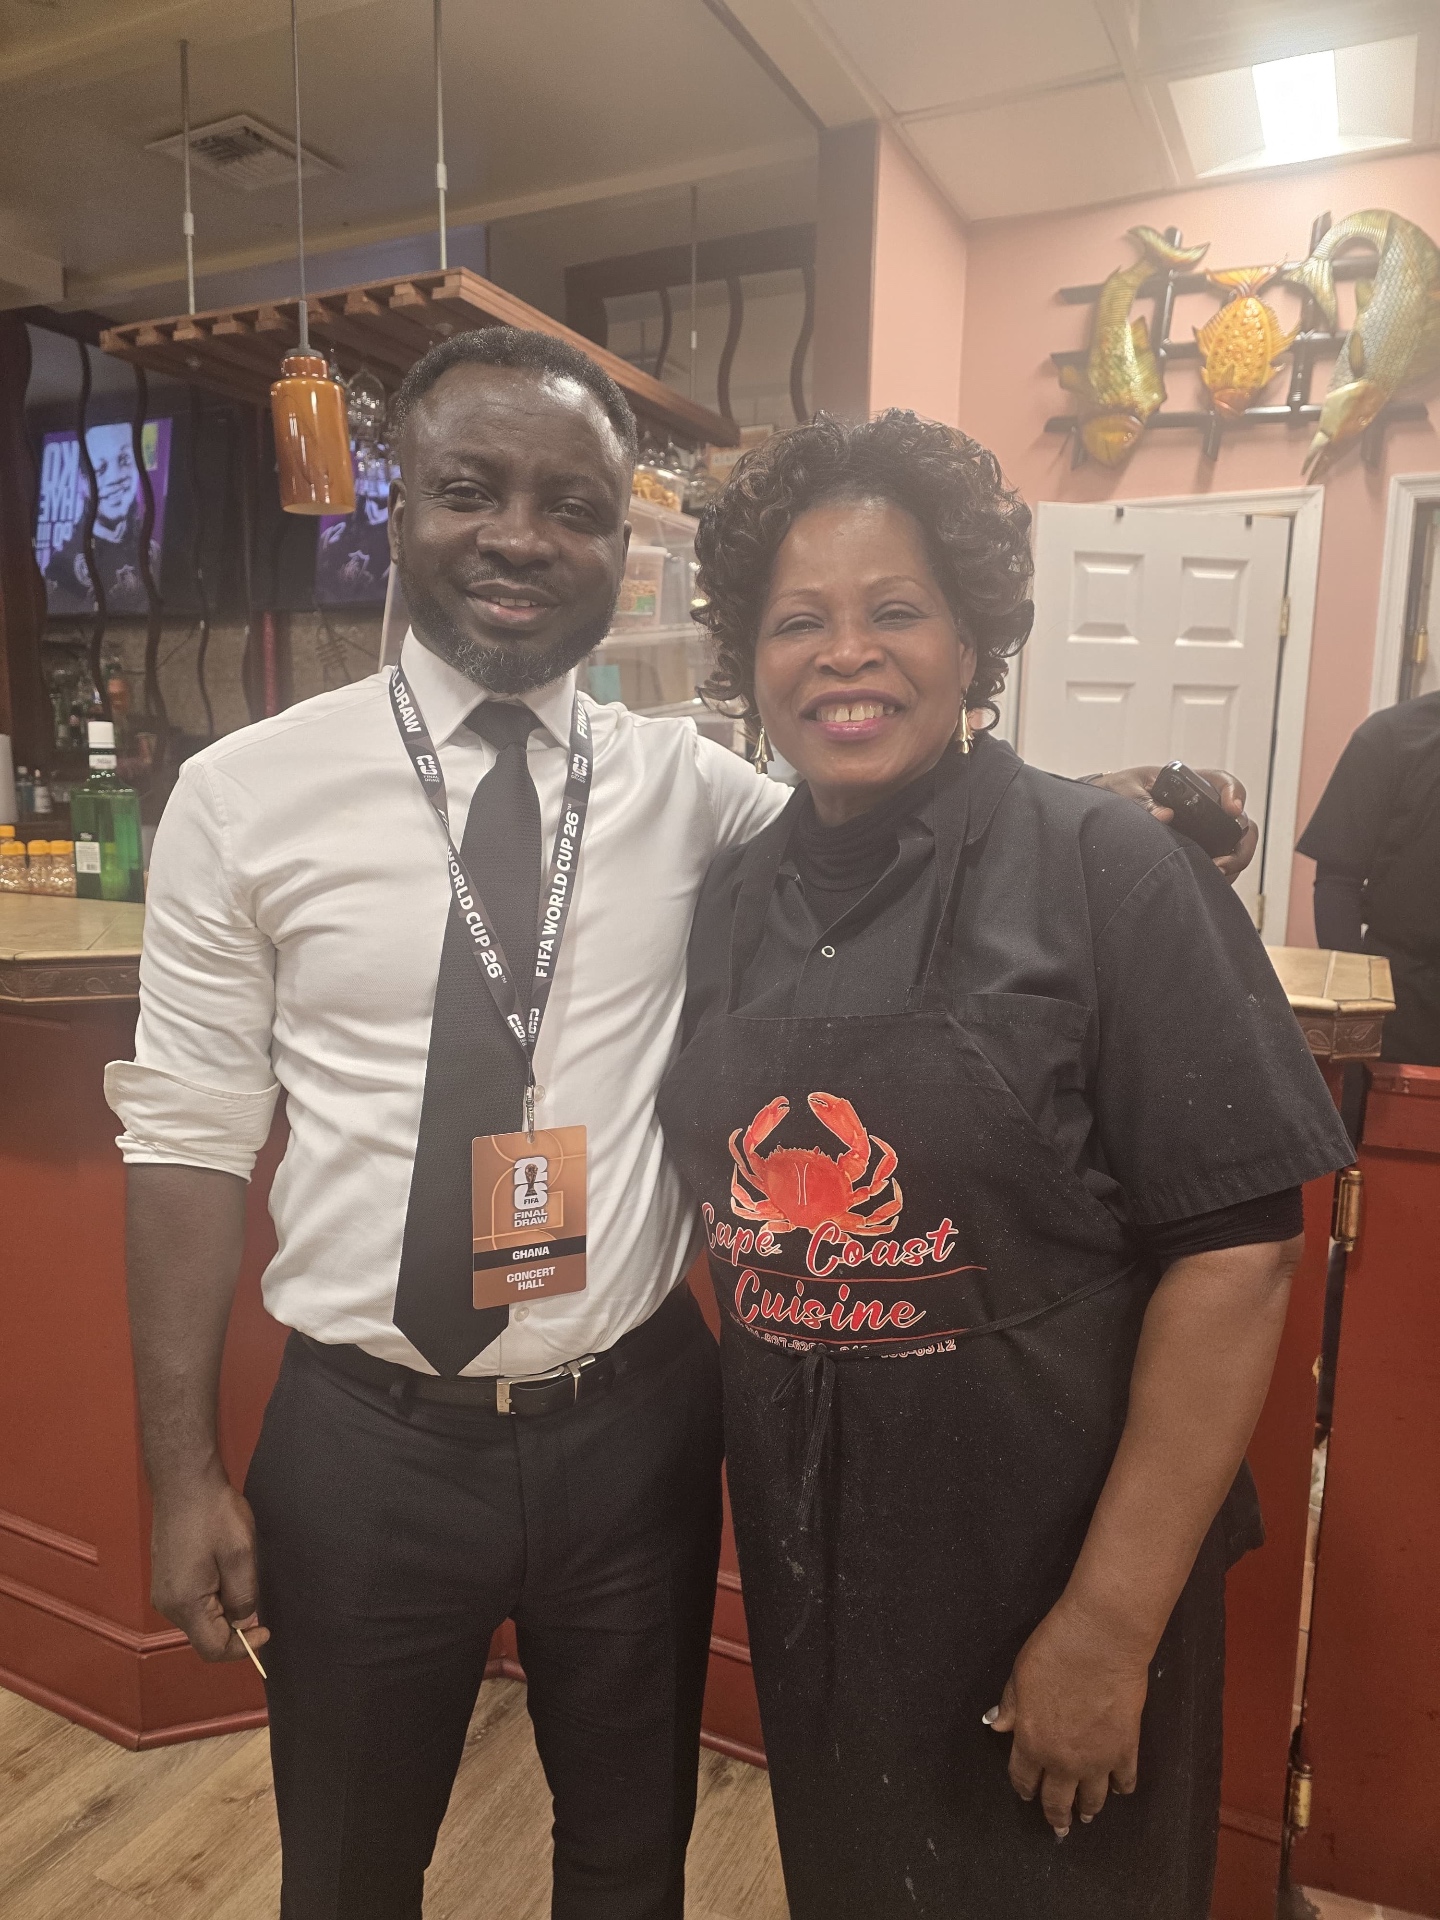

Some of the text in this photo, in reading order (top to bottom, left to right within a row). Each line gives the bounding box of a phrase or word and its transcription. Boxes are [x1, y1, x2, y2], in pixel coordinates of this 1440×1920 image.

[394, 682, 421, 733] DRAW
[556, 838, 574, 872] CUP
[542, 873, 568, 935] WORLD
[465, 911, 491, 948] CUP
[535, 939, 555, 978] FIFA
[514, 1208, 548, 1220] FINAL
[523, 1197, 539, 1205] FIFA
[514, 1216, 548, 1228] DRAW
[702, 1202, 959, 1276] Cape Coast
[512, 1246, 550, 1260] GHANA
[506, 1266, 556, 1283] CONCERT
[517, 1279, 545, 1291] HALL
[735, 1269, 926, 1331] Cuisine
